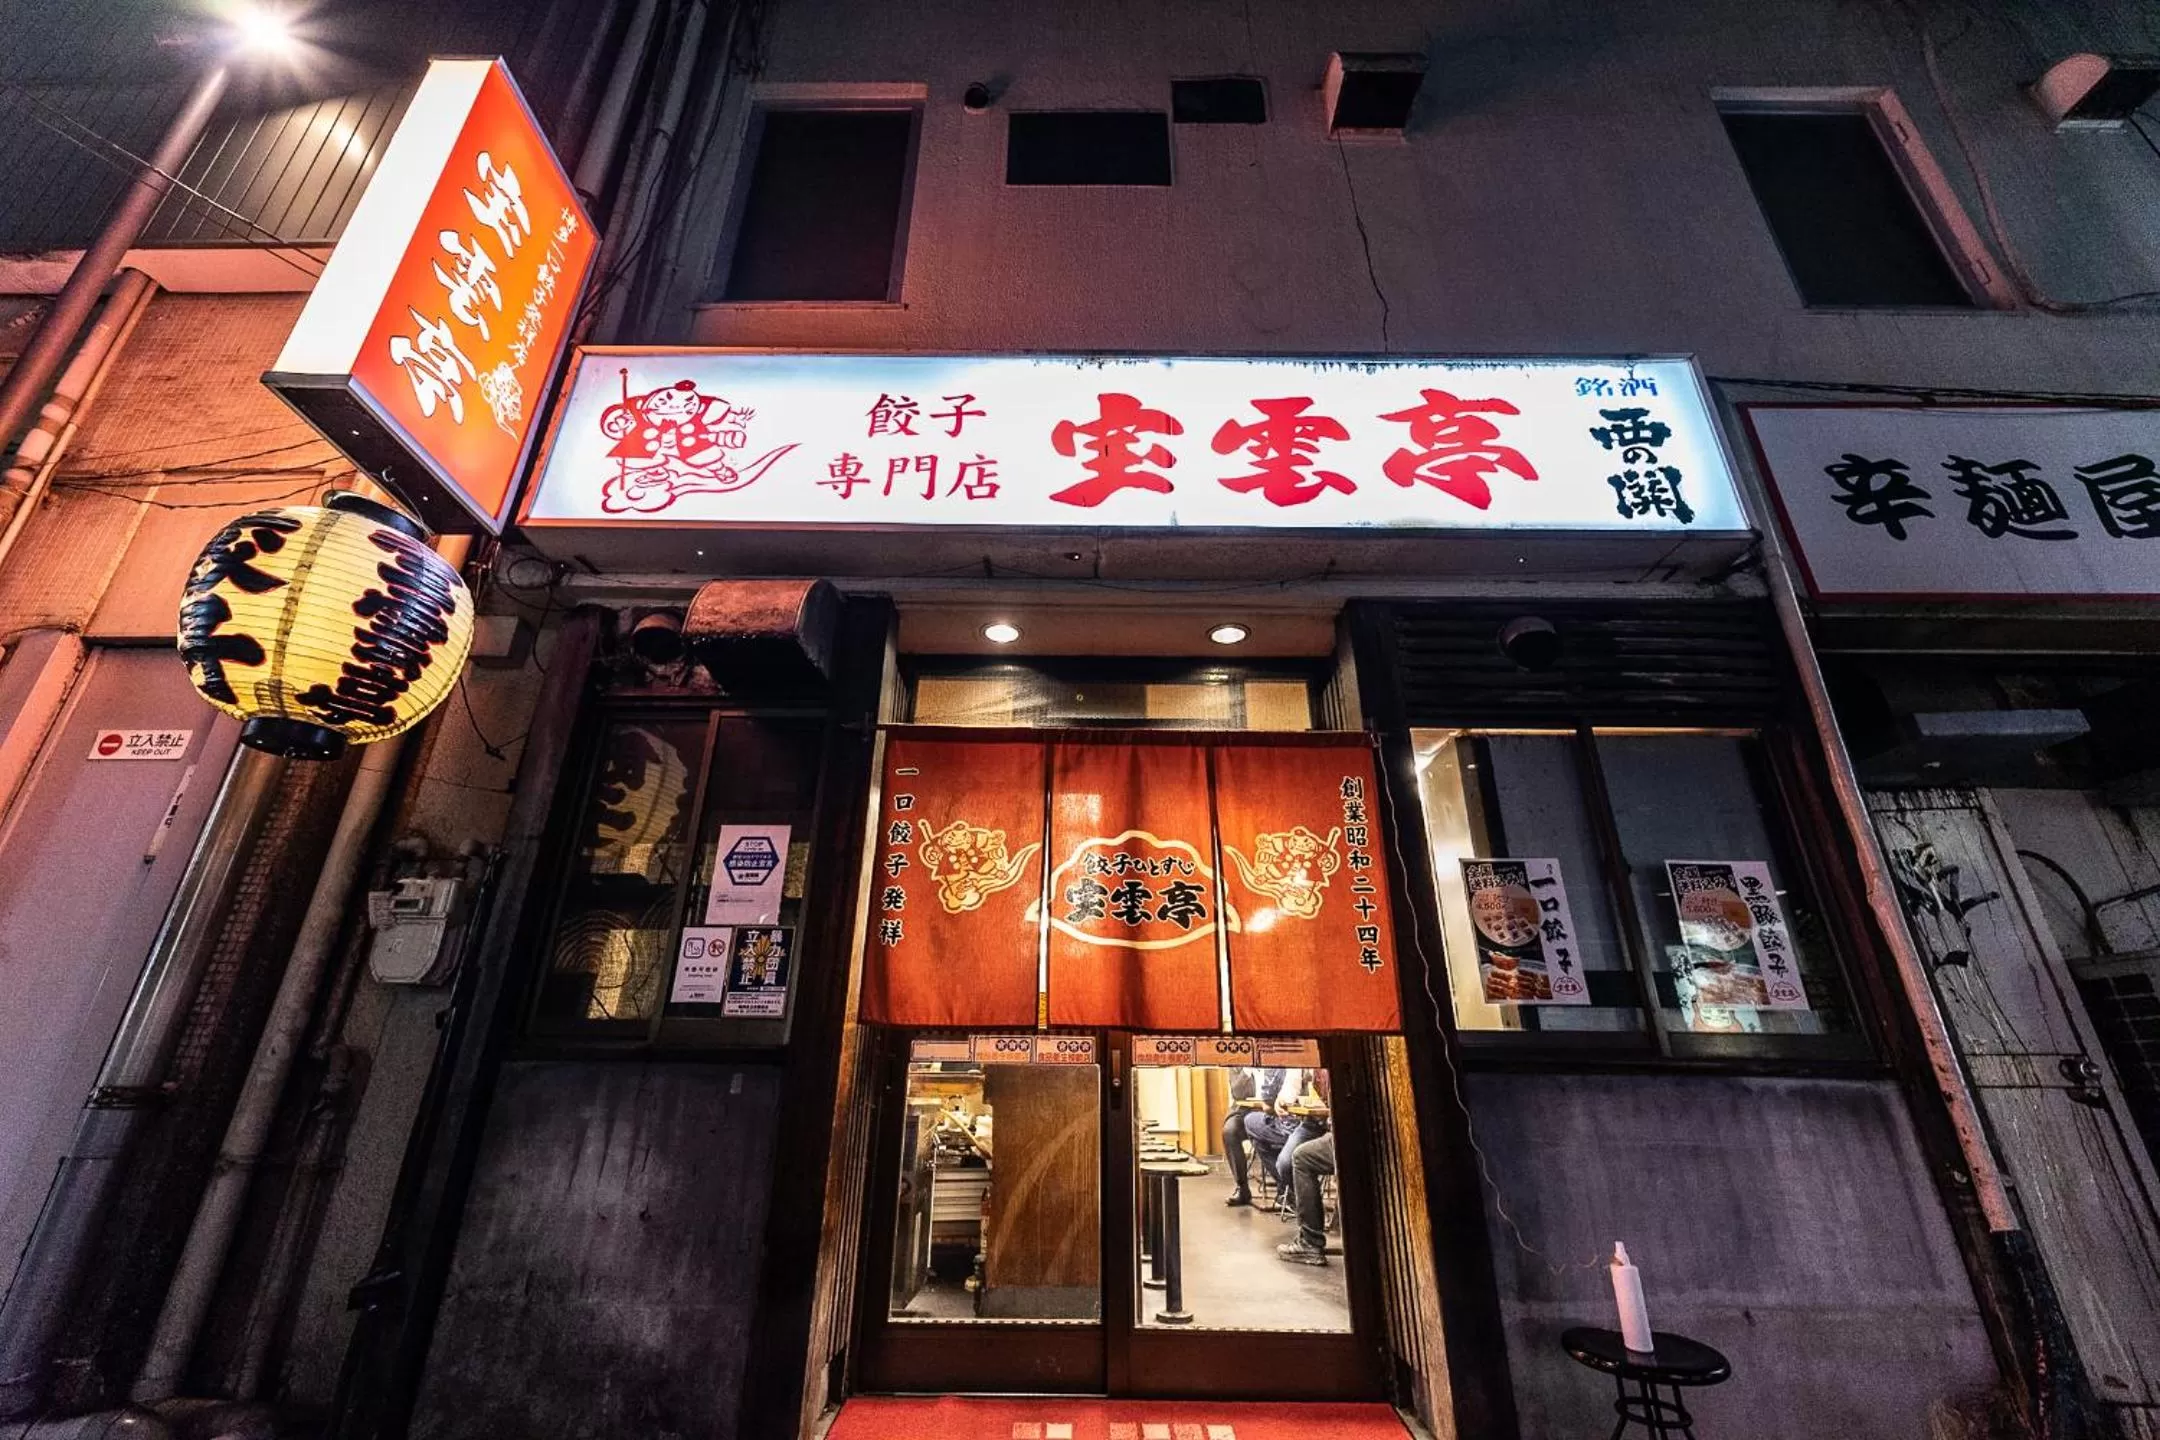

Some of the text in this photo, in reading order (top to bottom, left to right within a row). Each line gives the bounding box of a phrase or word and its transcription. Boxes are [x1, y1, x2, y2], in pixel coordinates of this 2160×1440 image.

[389, 150, 531, 425] 宝雲亭
[865, 393, 987, 438] 餃子
[1049, 388, 1540, 511] 宝雲亭
[815, 452, 1003, 501] 専門店
[126, 734, 184, 747] 立入禁止
[878, 765, 920, 947] 一口餃子発祥
[1084, 852, 1195, 876] 餃子ひとすじ
[1340, 775, 1383, 972] 創業昭和二十四年
[1065, 878, 1207, 929] 宝雲亭
[1529, 877, 1573, 976] 一口餃子
[1740, 876, 1789, 978] 黒豚餃子
[738, 930, 760, 985] 立入禁止
